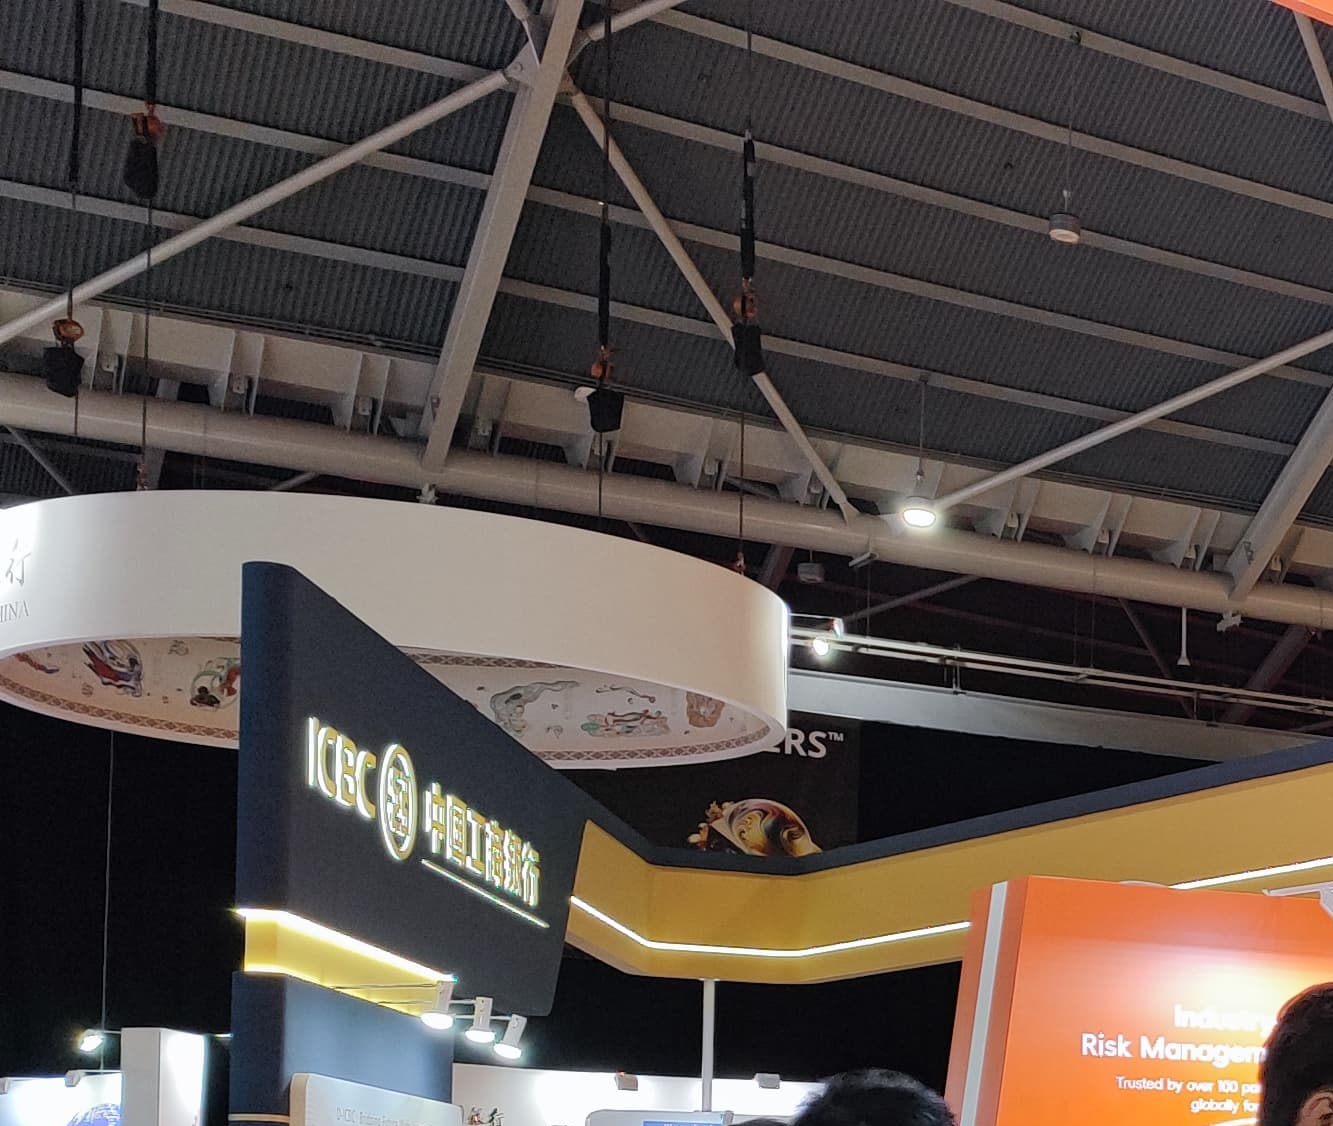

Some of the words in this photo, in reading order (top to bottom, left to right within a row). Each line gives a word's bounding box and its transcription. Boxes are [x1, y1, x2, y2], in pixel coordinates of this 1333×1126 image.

[0, 599, 30, 623] INA
[306, 715, 377, 821] ICBC
[1081, 1032, 1134, 1058] Risk
[1116, 1076, 1164, 1091] Trusted
[1167, 1077, 1184, 1094] by
[1186, 1082, 1214, 1094] over
[1217, 1080, 1239, 1094] 100
[1190, 1098, 1238, 1114] globally
